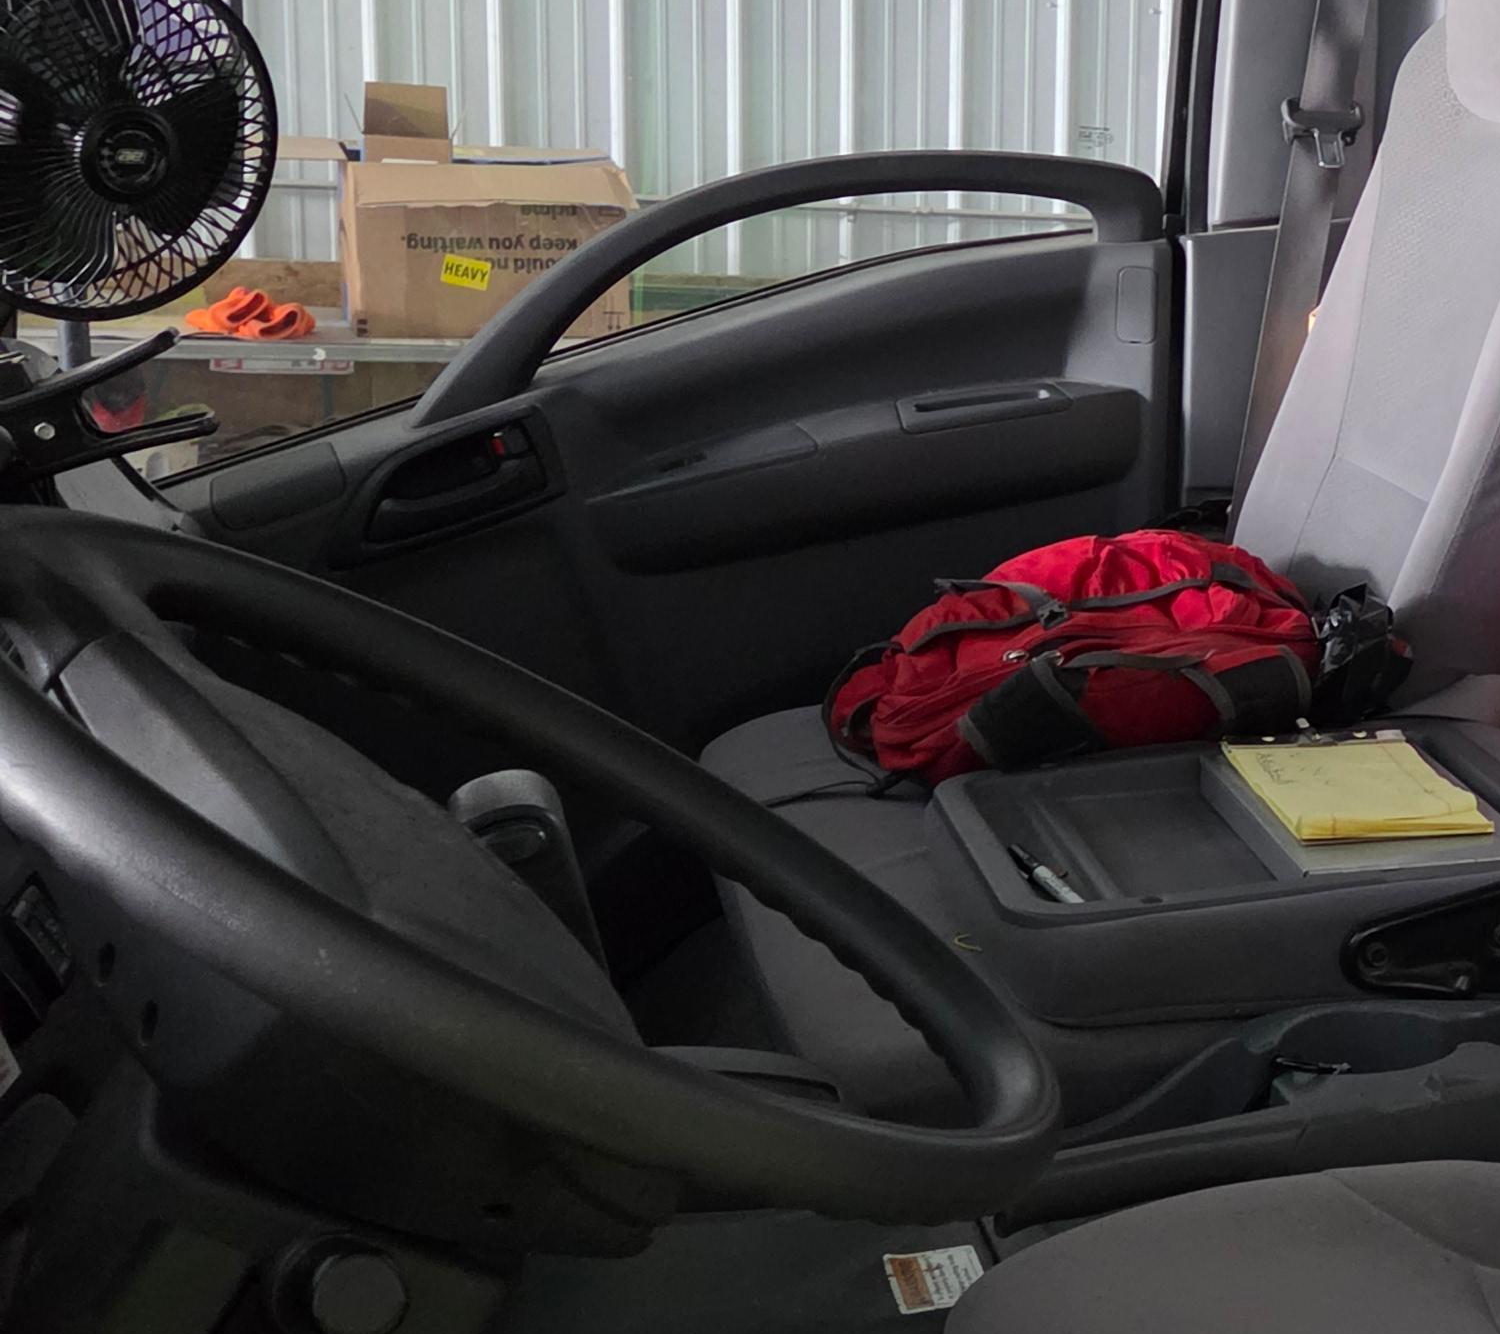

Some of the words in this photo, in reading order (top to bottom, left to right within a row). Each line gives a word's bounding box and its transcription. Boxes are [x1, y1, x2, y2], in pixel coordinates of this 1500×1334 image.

[401, 233, 483, 253] waiting.
[488, 234, 525, 250] you
[529, 234, 578, 252] keep
[443, 261, 488, 283] HEAVY
